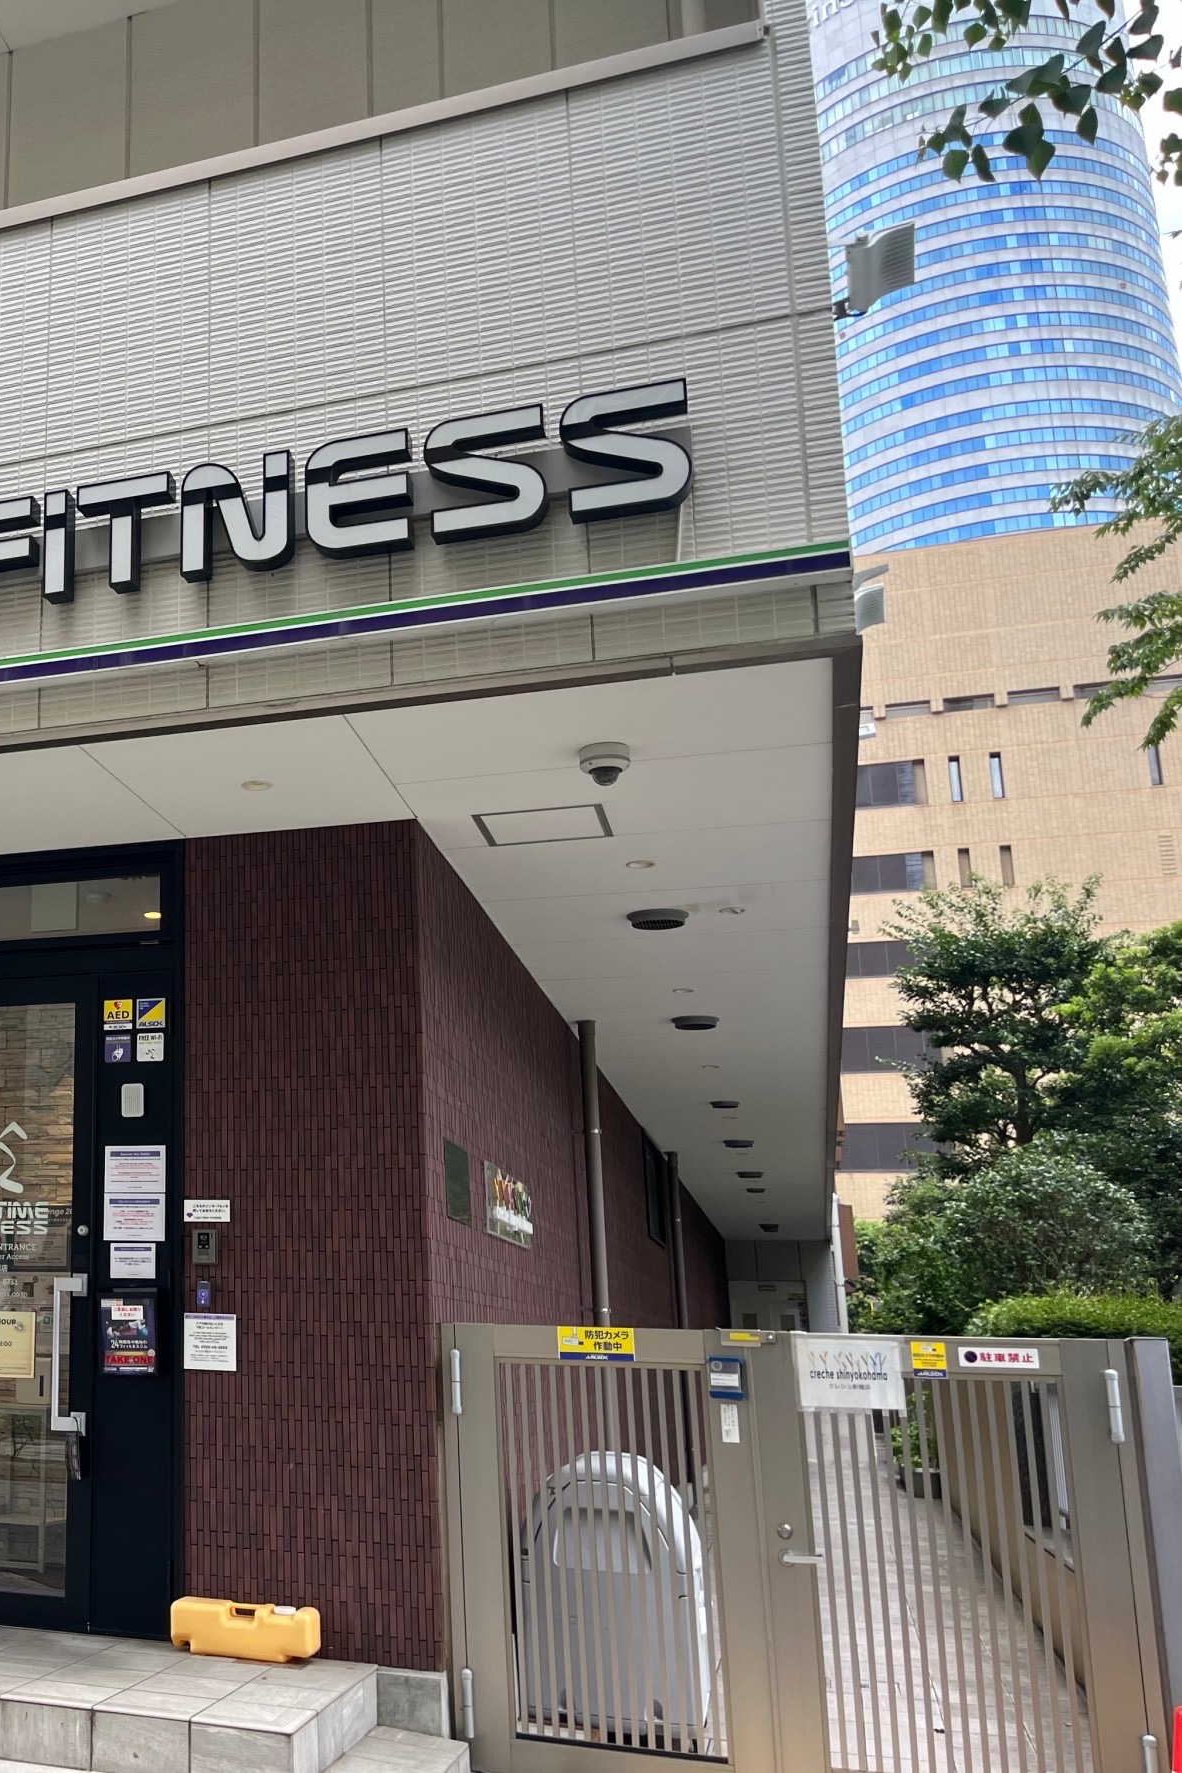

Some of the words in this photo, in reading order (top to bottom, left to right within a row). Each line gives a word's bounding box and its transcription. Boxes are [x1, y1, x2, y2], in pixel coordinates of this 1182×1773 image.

[107, 1010, 130, 1020] AED
[138, 1020, 164, 1028] ALSOK
[584, 1330, 629, 1340] 防犯カメラ
[593, 1341, 622, 1351] 作動中
[105, 1356, 129, 1364] TAKE
[133, 1355, 154, 1364] ONE
[979, 1352, 1034, 1363] 駐車禁止
[810, 1368, 834, 1380] creche
[836, 1368, 888, 1382] shinyokohama
